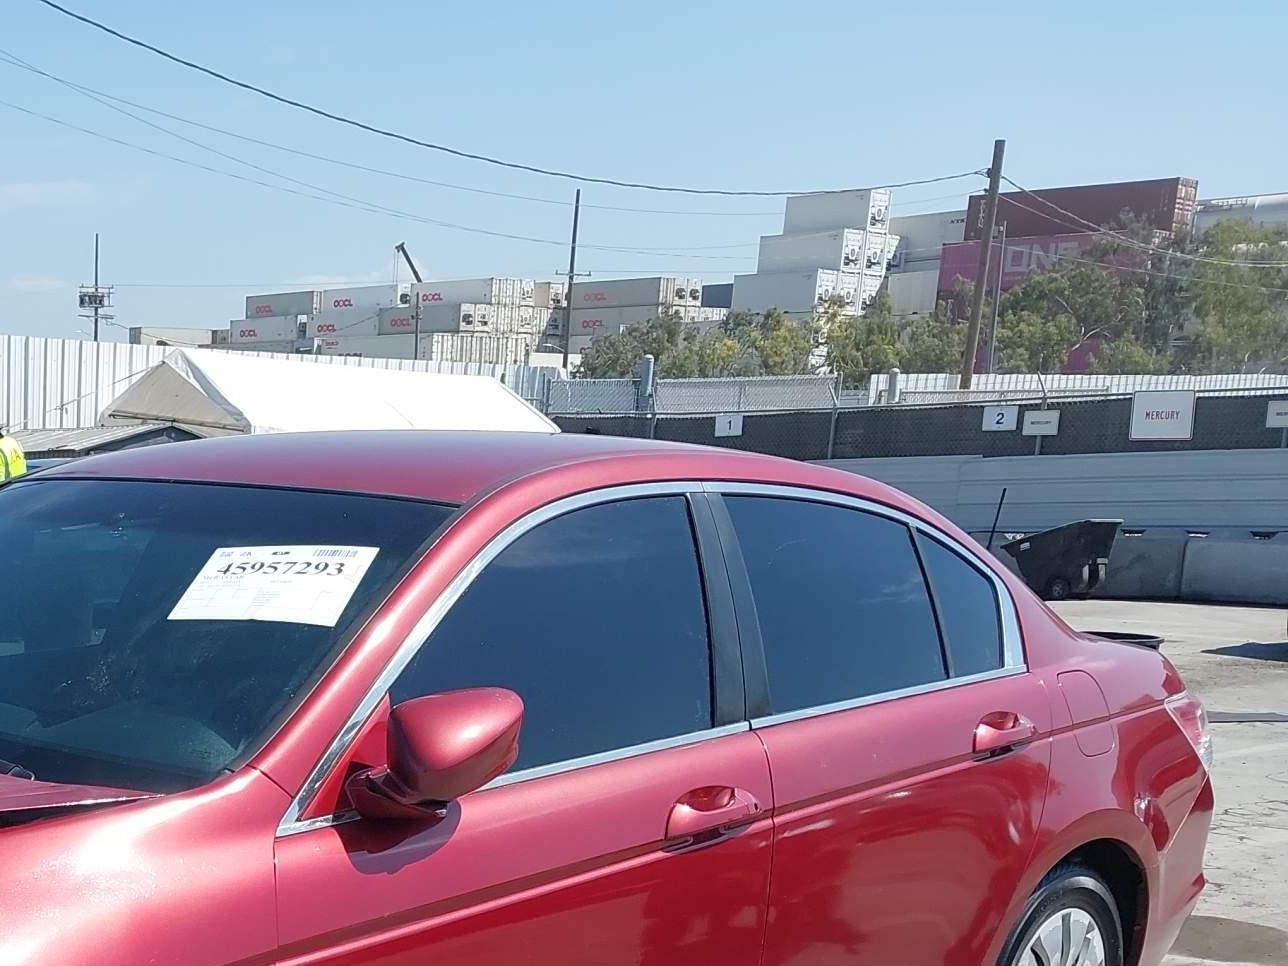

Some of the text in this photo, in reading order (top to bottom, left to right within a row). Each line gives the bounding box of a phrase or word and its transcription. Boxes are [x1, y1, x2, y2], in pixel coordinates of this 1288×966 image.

[1005, 241, 1079, 273] ONE
[422, 293, 443, 301] OOCL
[334, 299, 353, 308] OOCL
[255, 305, 273, 314] OOCL
[390, 318, 411, 327] OOCL
[317, 324, 336, 333] OOCL
[240, 329, 257, 338] OOCL
[995, 412, 1005, 425] 2
[1144, 410, 1180, 420] MERCURY
[217, 562, 345, 576] 45957293
